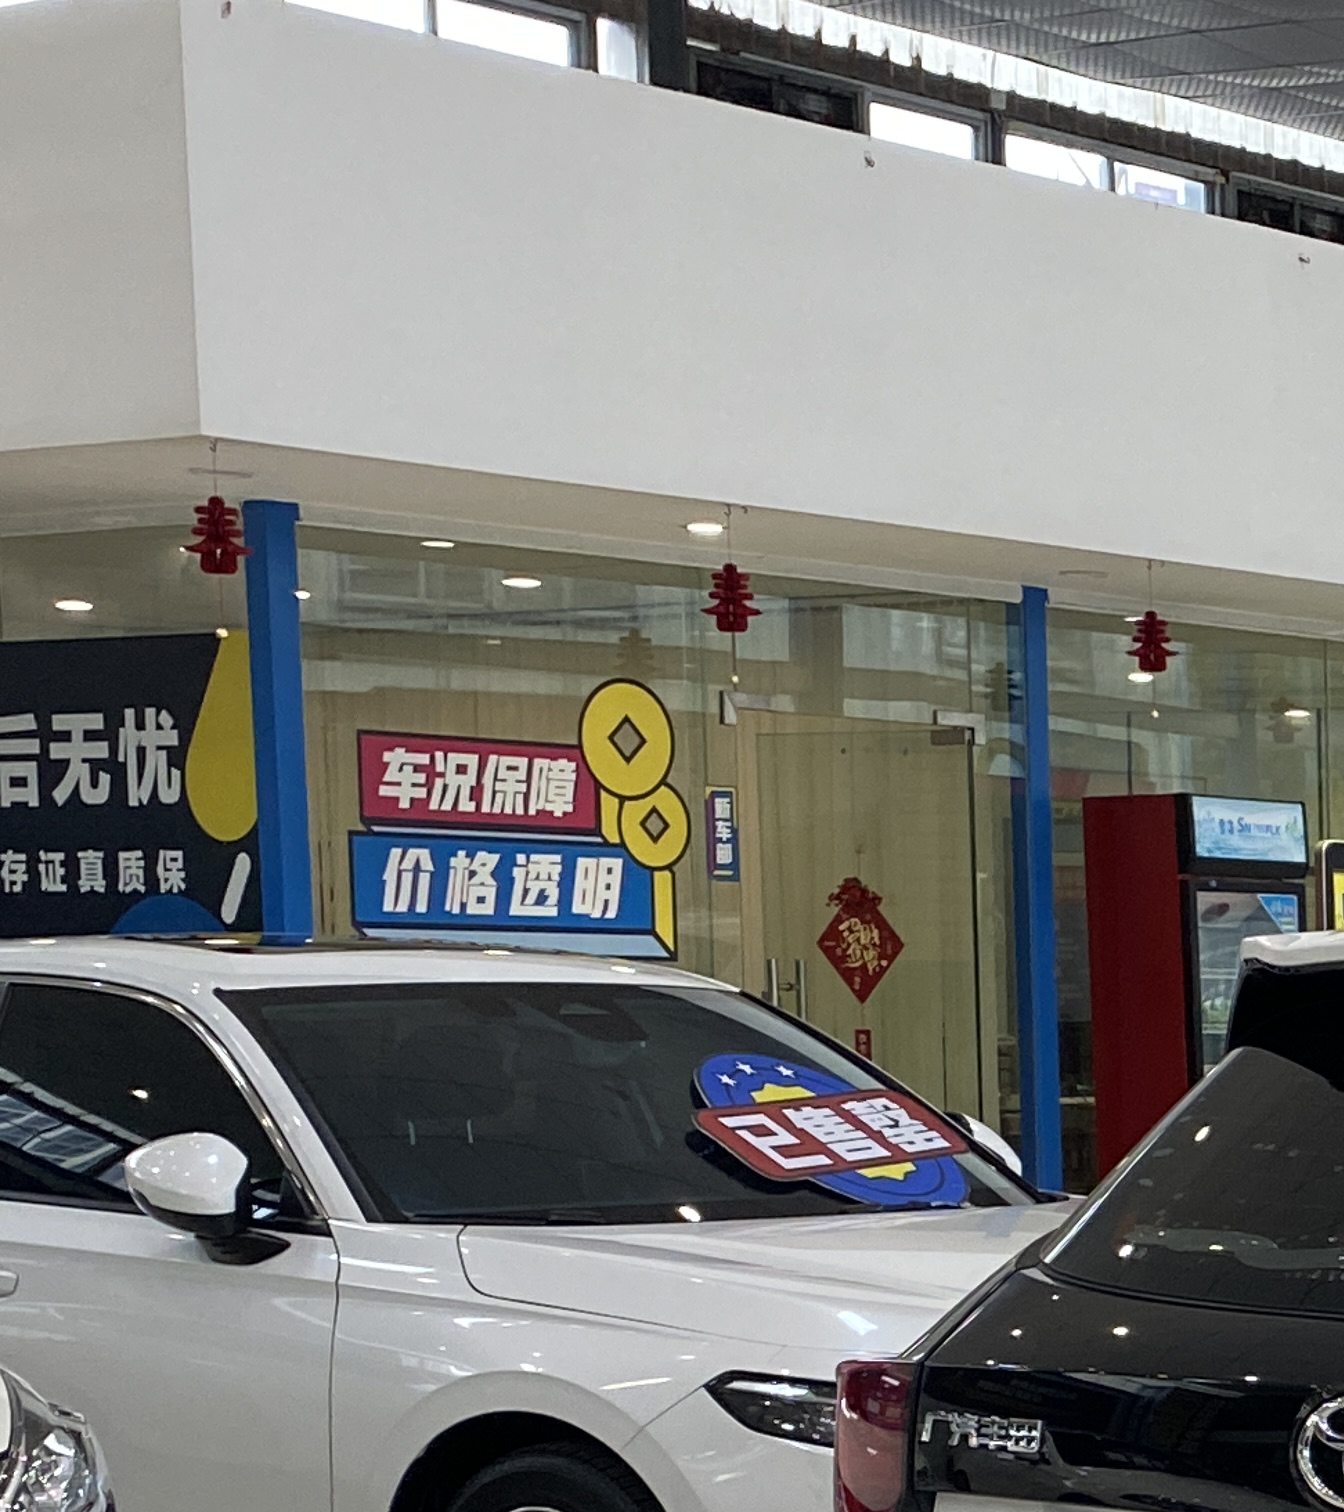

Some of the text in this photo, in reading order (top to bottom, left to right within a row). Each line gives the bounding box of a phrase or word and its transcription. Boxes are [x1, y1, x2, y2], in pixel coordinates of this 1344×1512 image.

[0, 707, 181, 808] 后无忧
[379, 746, 578, 817] 车况保障
[0, 849, 186, 894] 存证真质保
[381, 847, 624, 919] 价格透明
[717, 1097, 952, 1169] 已售罄
